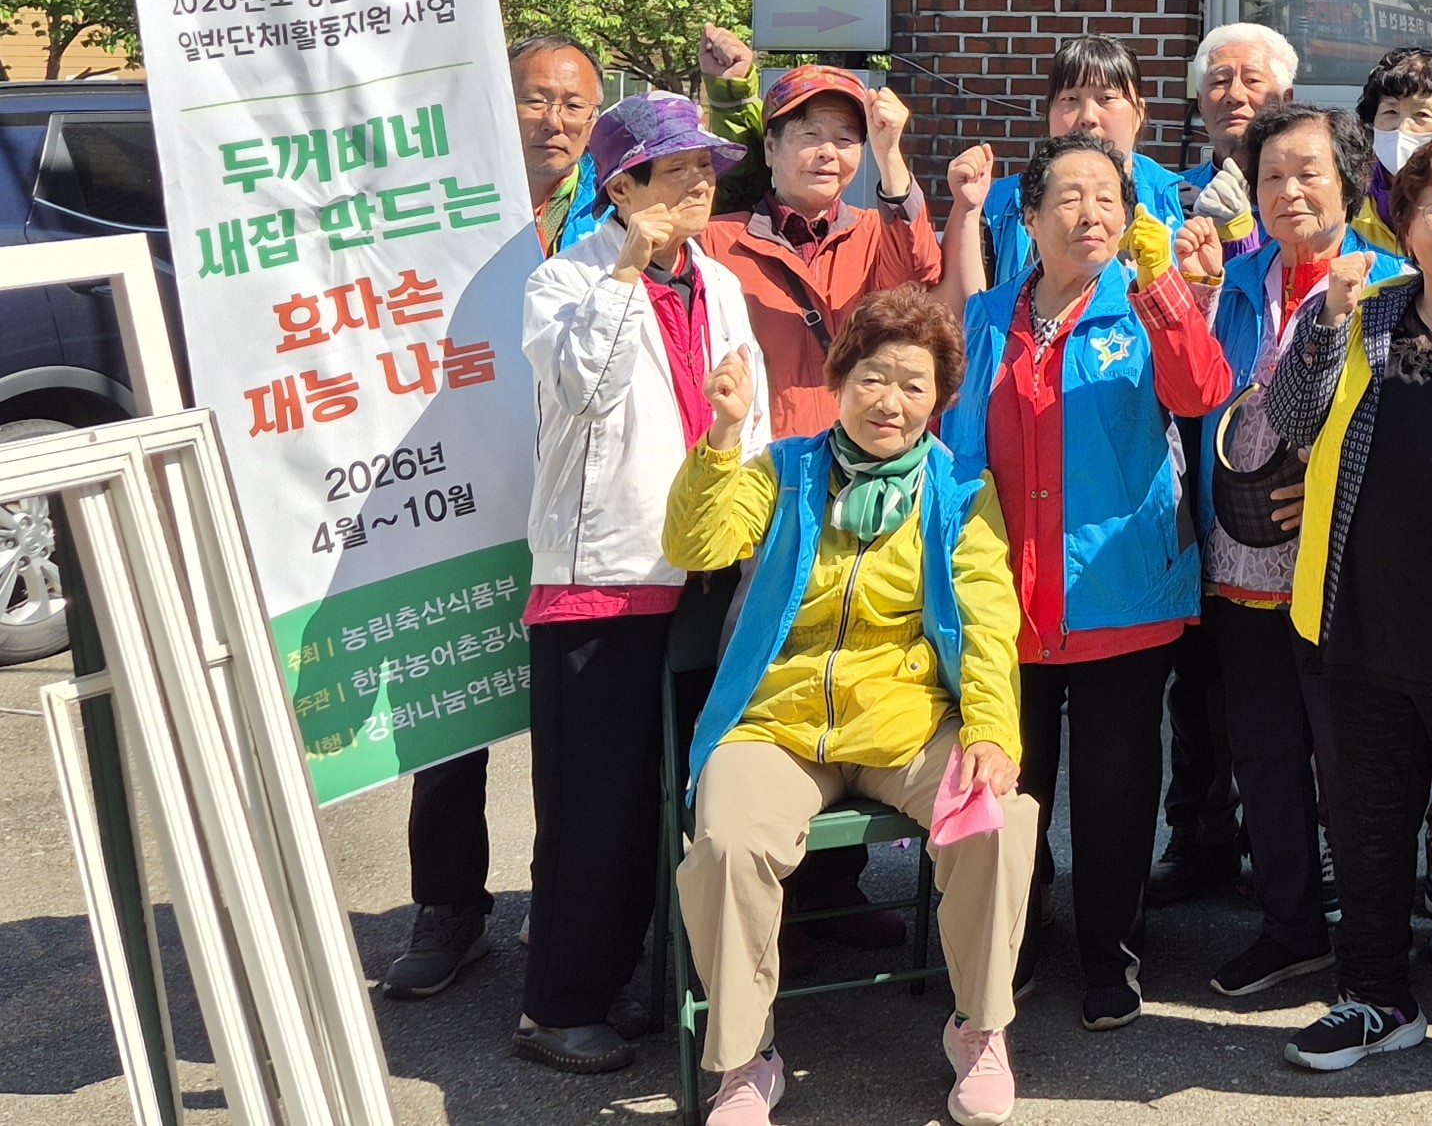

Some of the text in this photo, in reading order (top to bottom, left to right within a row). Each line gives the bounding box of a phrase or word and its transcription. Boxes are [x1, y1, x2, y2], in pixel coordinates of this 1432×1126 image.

[178, 5, 393, 62] 일반단체활동지원
[219, 104, 450, 193] 두꺼비네
[195, 176, 501, 279] 새집 만드는
[272, 269, 444, 354] 효자손
[244, 337, 496, 437] 재능 나눔
[324, 441, 447, 502] 2026년
[312, 482, 476, 554] 4월~10월
[287, 575, 519, 672] 주최 농림축산식품부
[295, 617, 530, 717] 주관 한국농어촌공사
